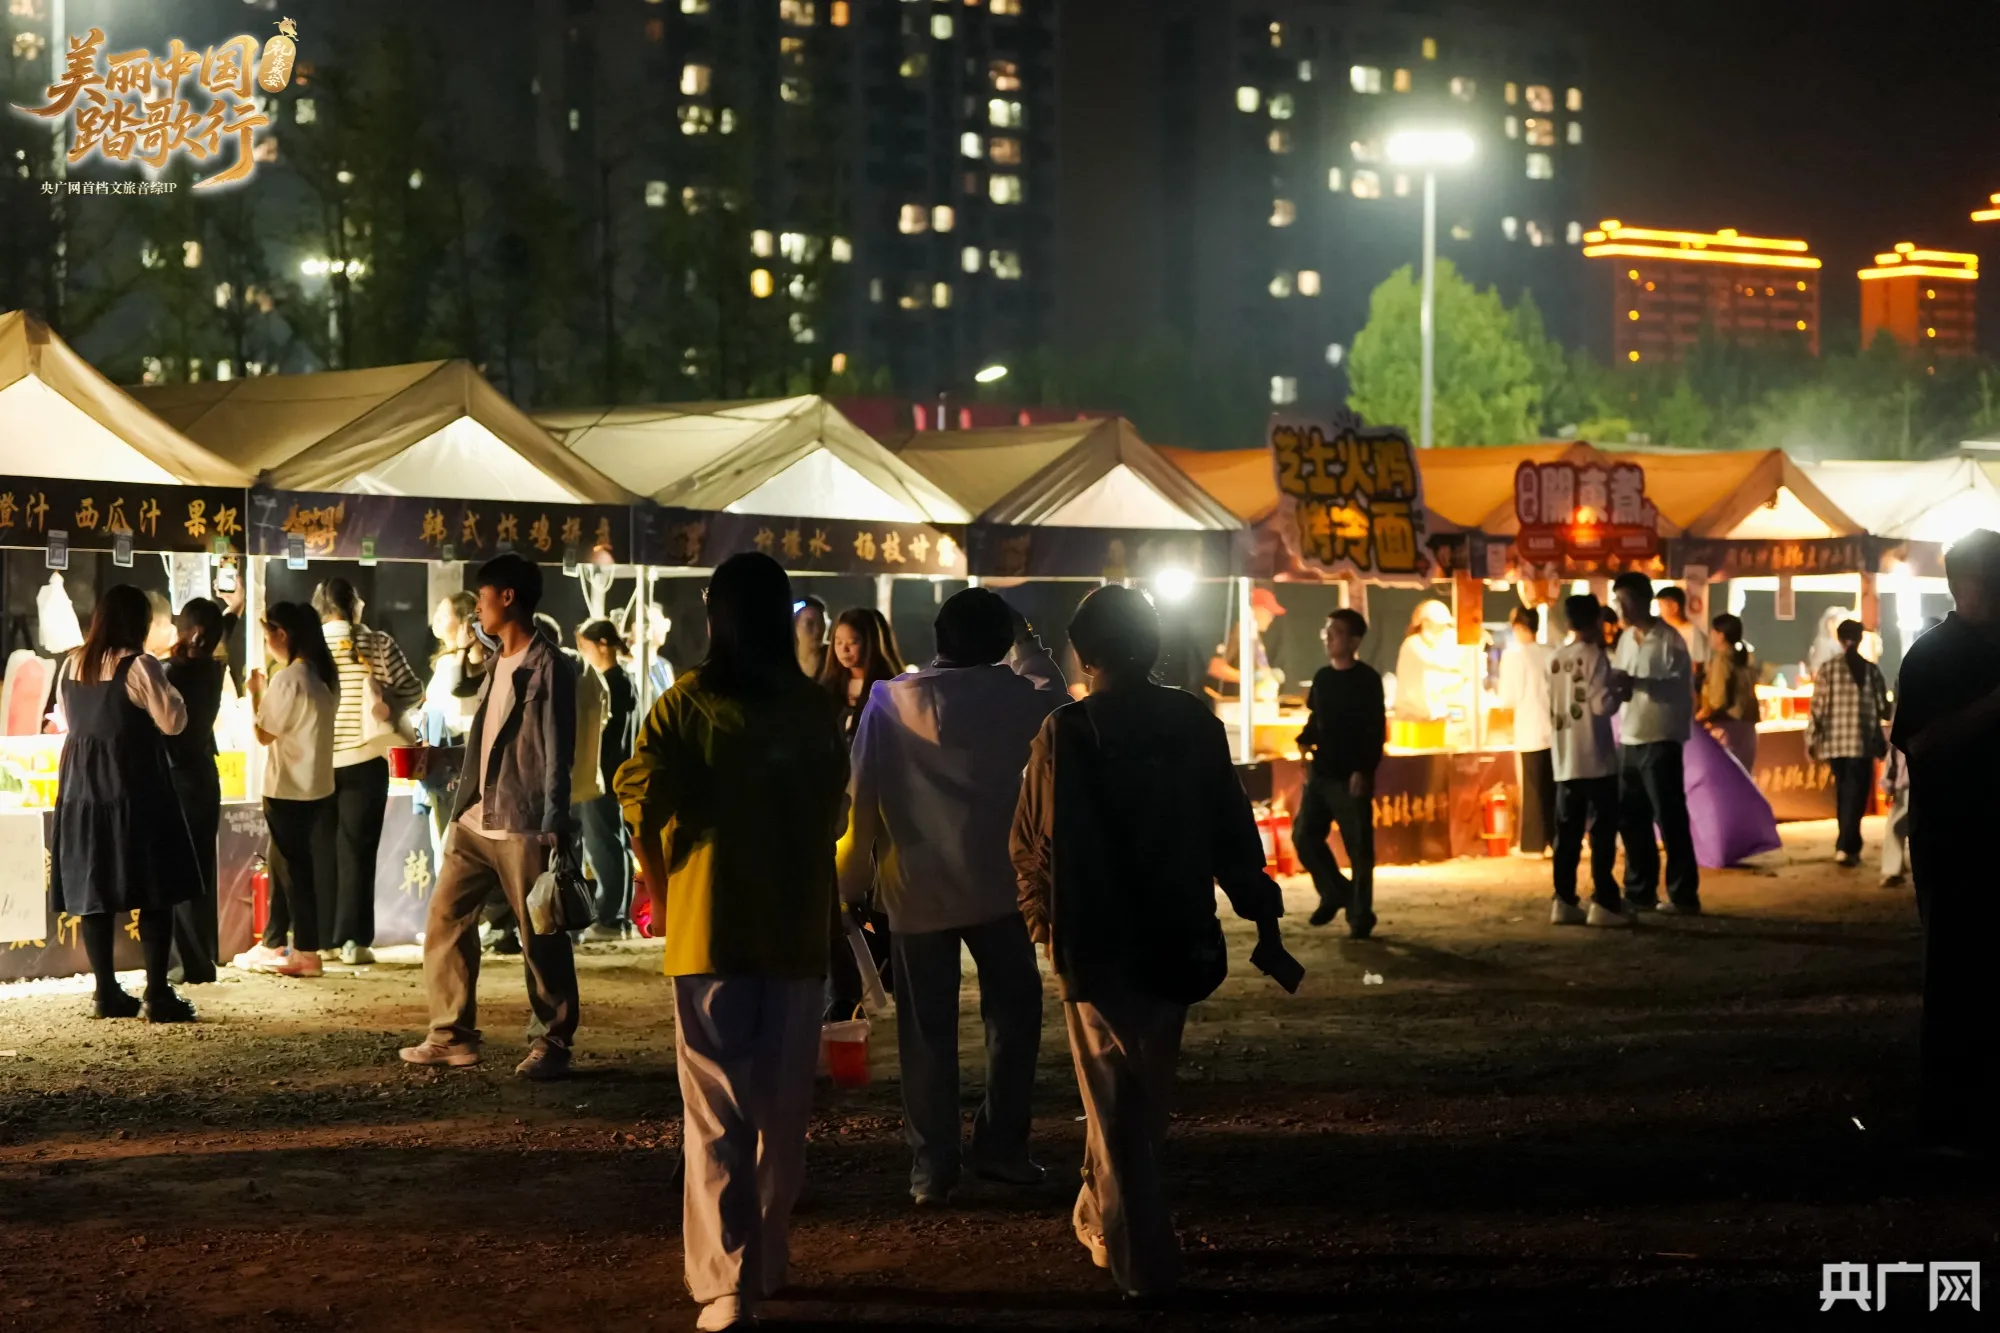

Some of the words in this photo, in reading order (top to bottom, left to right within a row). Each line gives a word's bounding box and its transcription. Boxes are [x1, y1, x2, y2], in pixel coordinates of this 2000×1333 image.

[75, 496, 161, 538] 西瓜汁
[184, 499, 242, 538] 果杯
